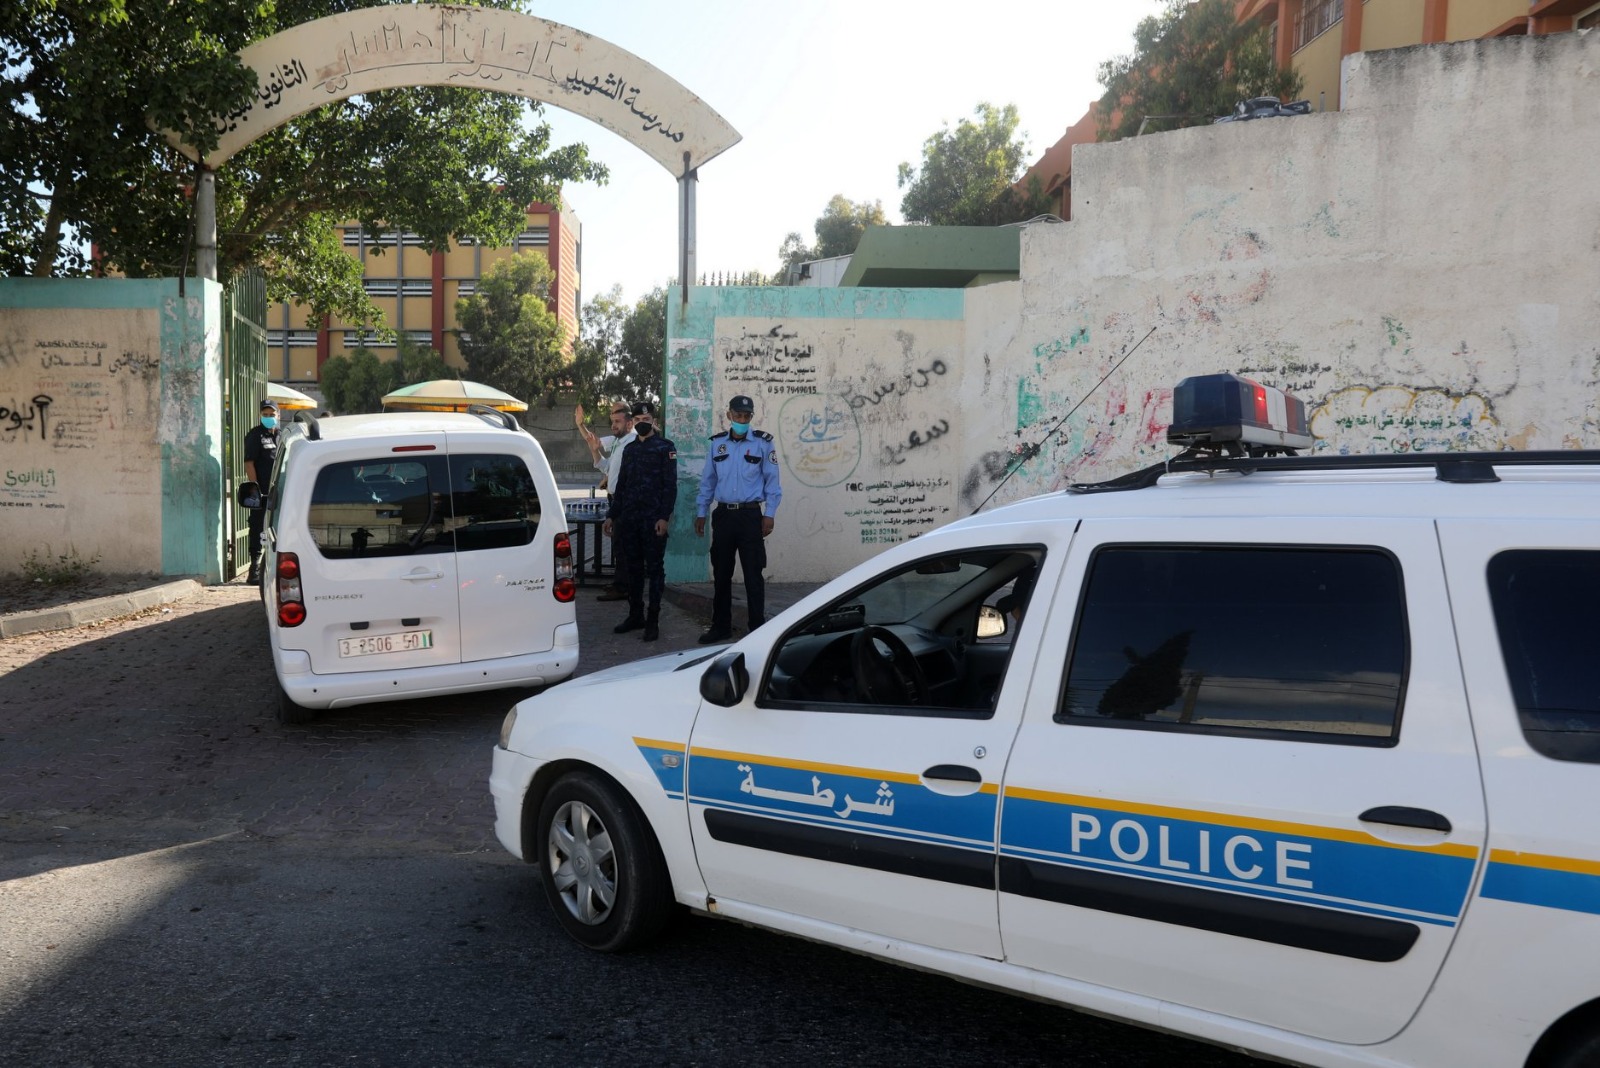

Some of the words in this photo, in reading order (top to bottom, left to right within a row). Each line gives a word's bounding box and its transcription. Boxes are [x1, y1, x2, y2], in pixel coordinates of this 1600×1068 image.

[255, 56, 308, 110] الثانوي
[565, 68, 628, 102] الشهيد
[215, 99, 253, 135] بنين
[624, 86, 684, 143] مدرسة
[737, 763, 895, 819] شرطة
[1070, 810, 1314, 890] POLICE
